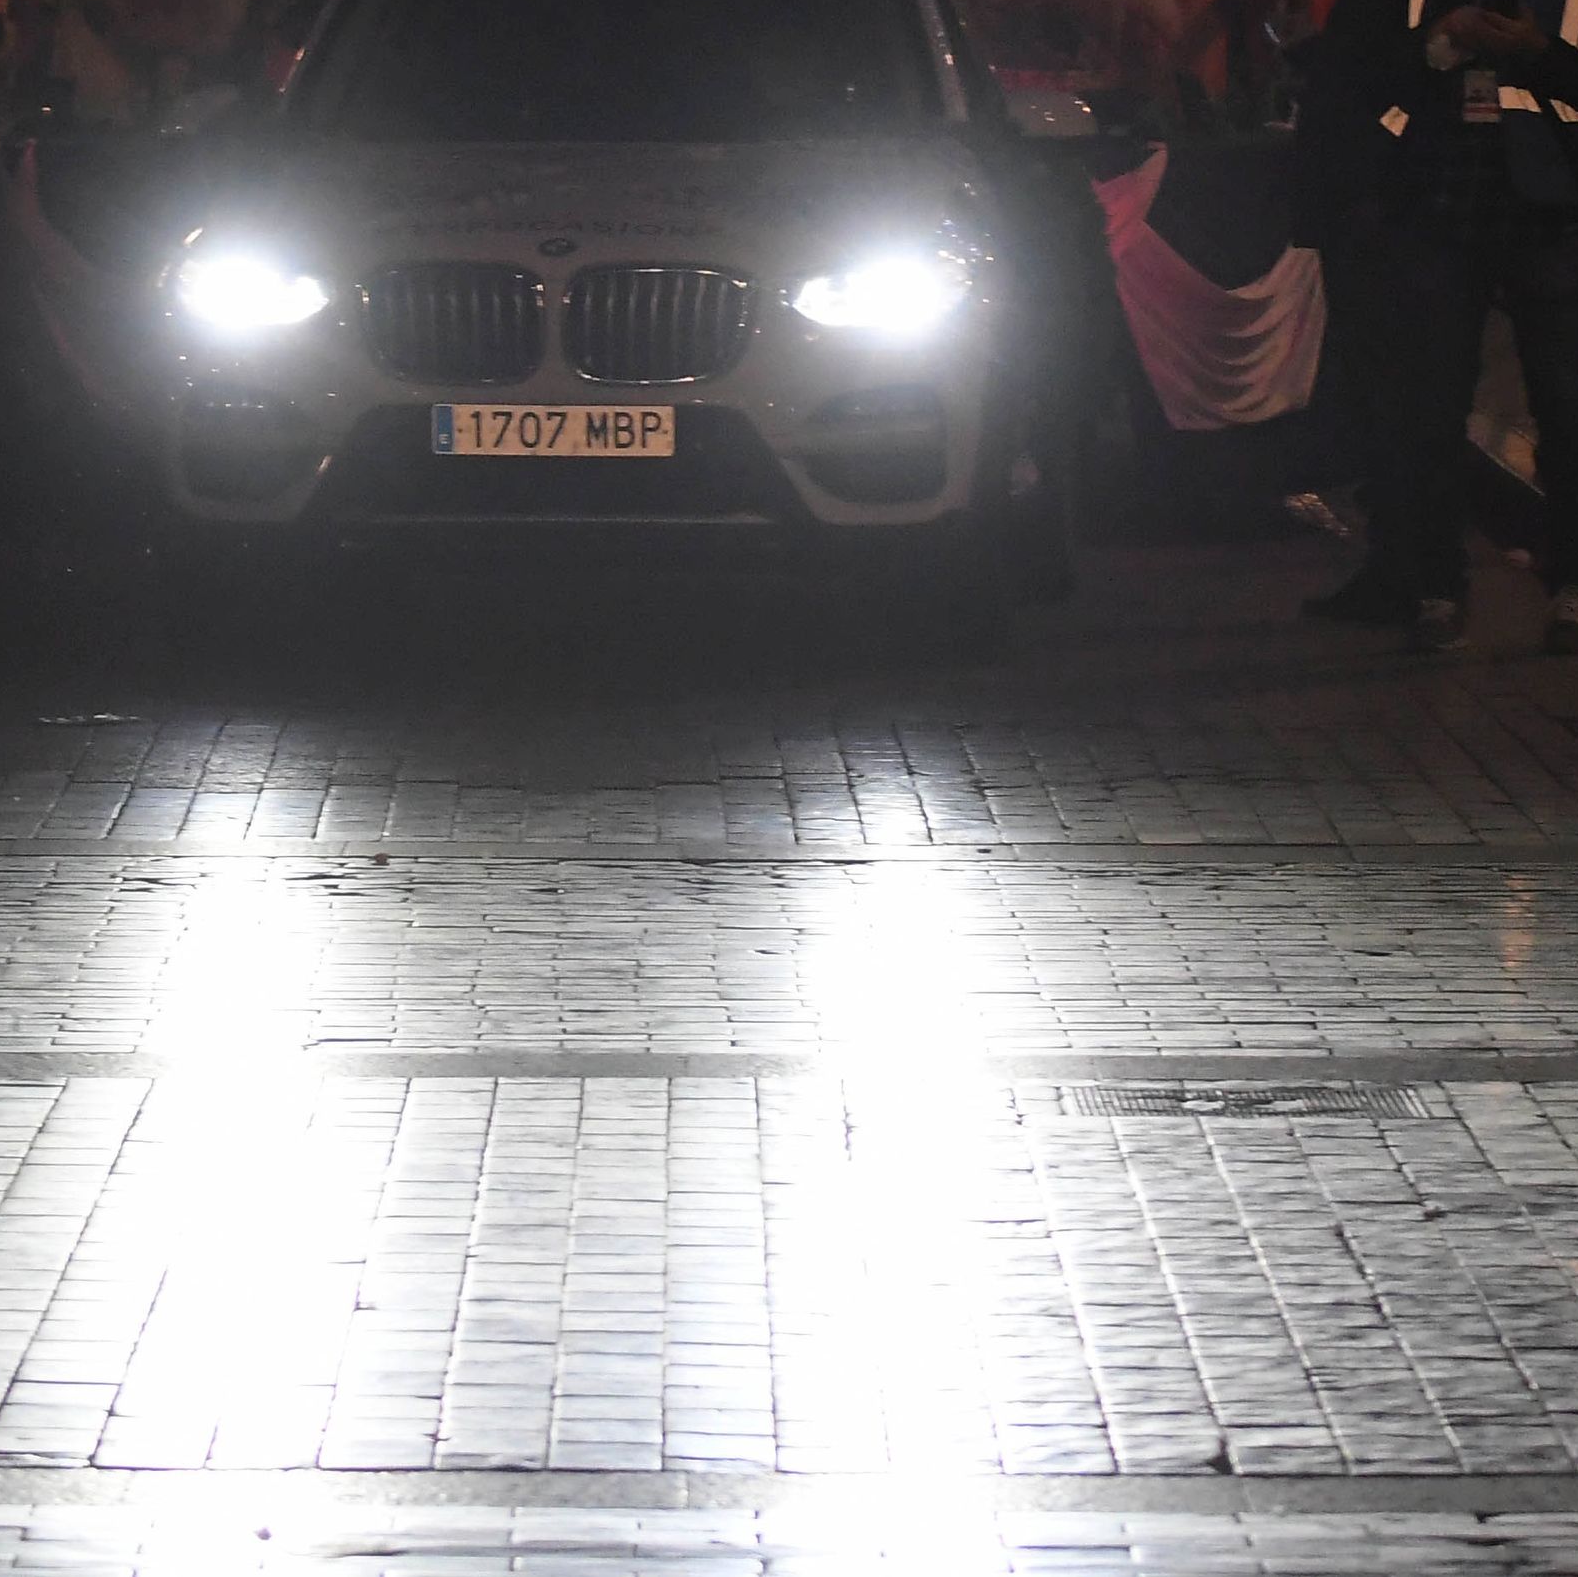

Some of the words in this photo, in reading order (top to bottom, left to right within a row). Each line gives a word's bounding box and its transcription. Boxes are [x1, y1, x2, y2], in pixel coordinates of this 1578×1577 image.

[438, 433, 449, 446] E
[470, 411, 567, 449] 1707
[586, 411, 662, 449] MBP
